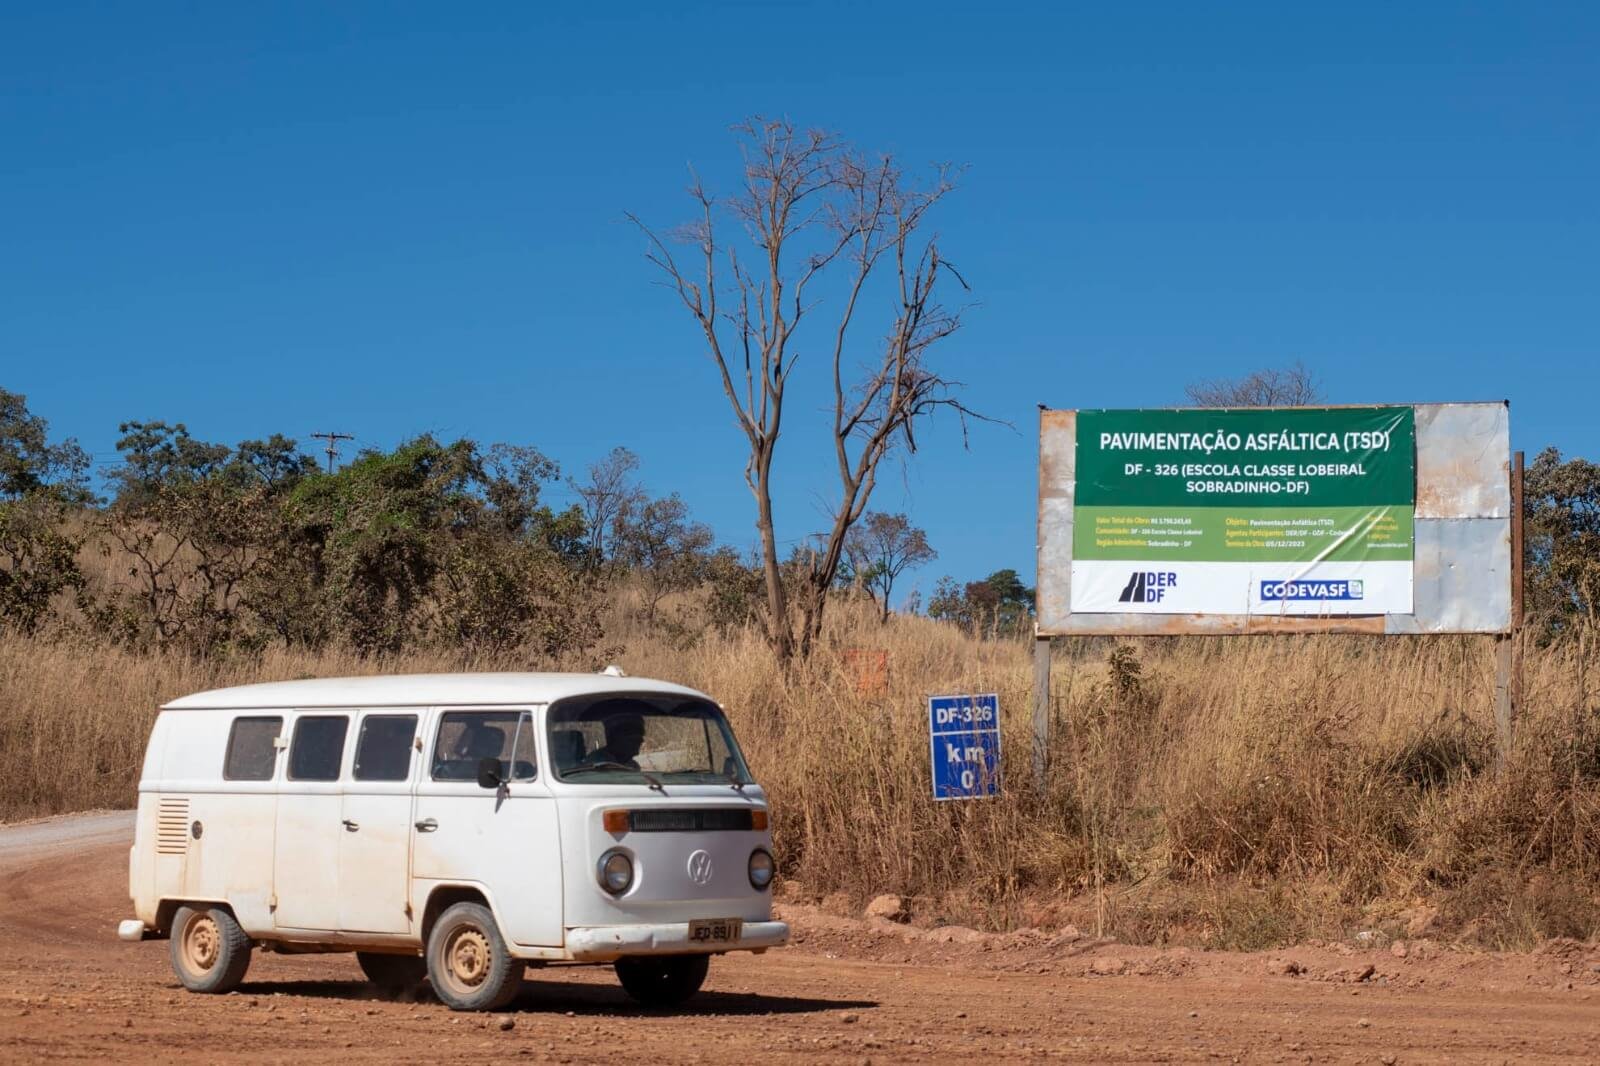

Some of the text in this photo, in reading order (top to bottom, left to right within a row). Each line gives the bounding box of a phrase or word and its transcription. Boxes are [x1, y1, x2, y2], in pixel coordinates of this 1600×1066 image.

[1100, 429, 1391, 455] PAVIMENTAÇÃO ASFÁLTICA (TSD)
[1125, 464, 1143, 476] DF
[1154, 464, 1178, 476] 326
[1182, 464, 1241, 478] (ESCOLA
[1244, 464, 1295, 476] CLASSE
[1298, 463, 1366, 476] LOBEIRAL
[1186, 481, 1310, 495] SOBRADINHO-DF)
[1249, 519, 1291, 528] Pavimentação
[1292, 518, 1317, 526] Asfáltica
[1318, 518, 1335, 527] (TSD)
[1146, 572, 1177, 587] DER
[1146, 588, 1165, 603] DF
[1263, 581, 1347, 598] CODEVASF
[936, 706, 993, 724] DF-326
[961, 769, 974, 789] 0
